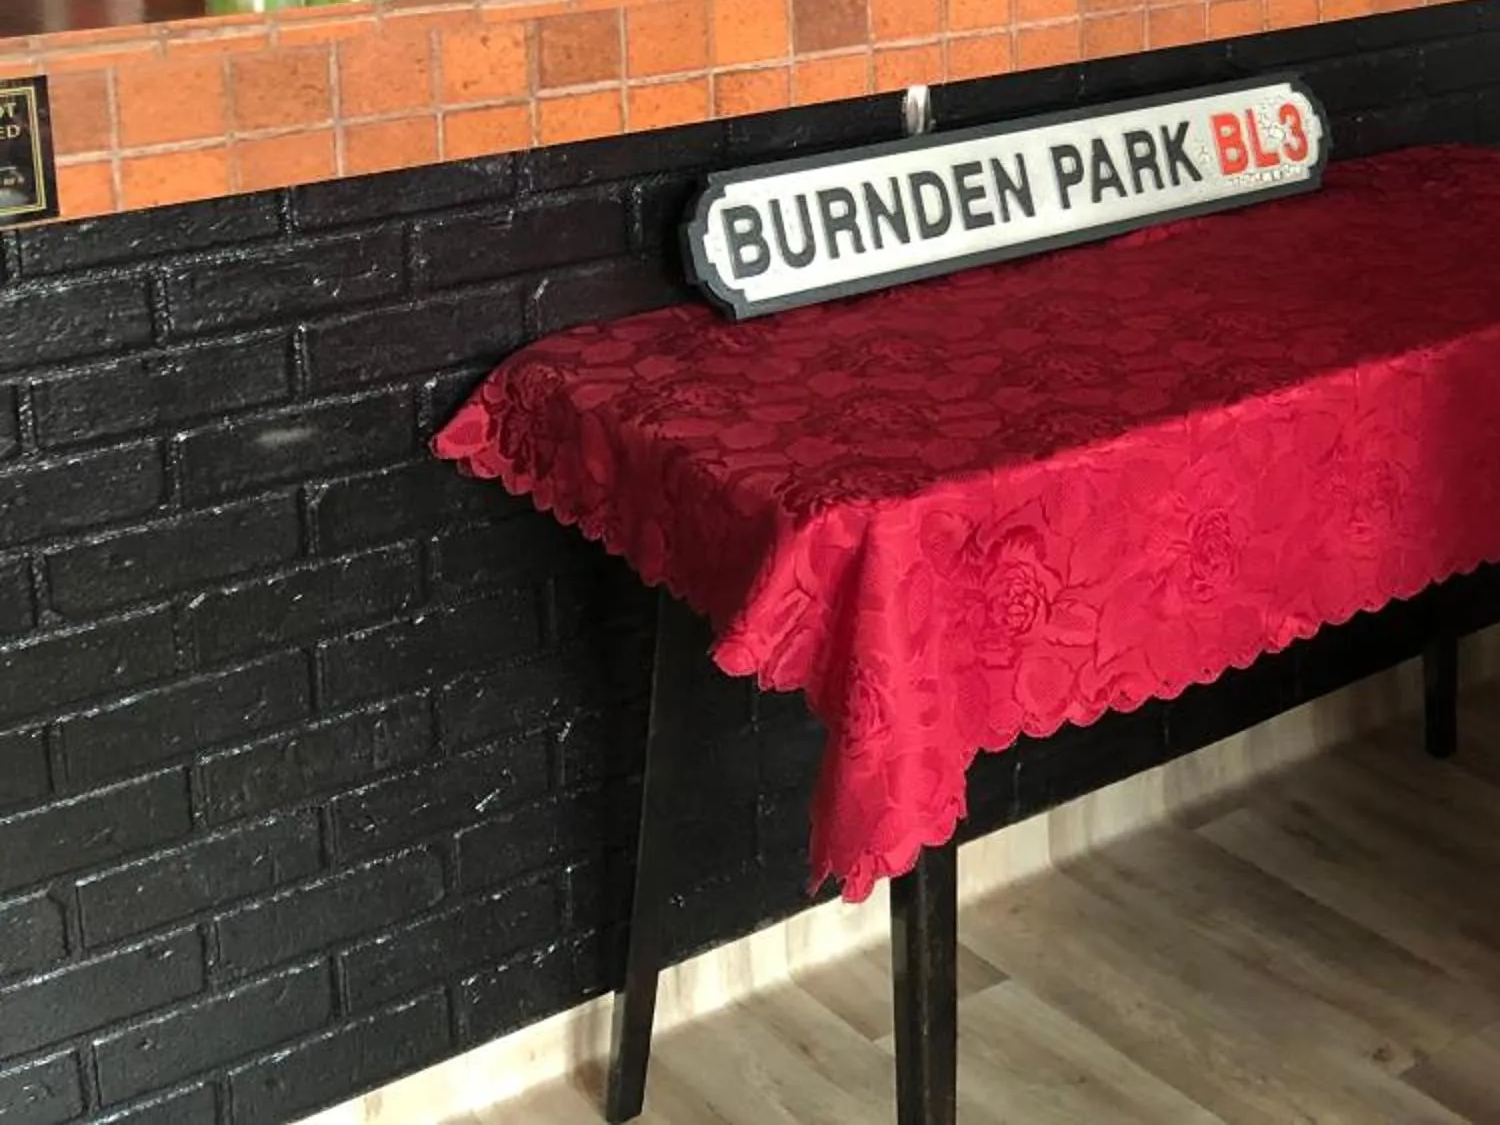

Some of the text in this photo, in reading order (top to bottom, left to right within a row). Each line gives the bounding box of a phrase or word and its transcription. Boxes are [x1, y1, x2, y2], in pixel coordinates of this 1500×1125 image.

[720, 102, 1309, 281] BURNDEN PARK BL3
